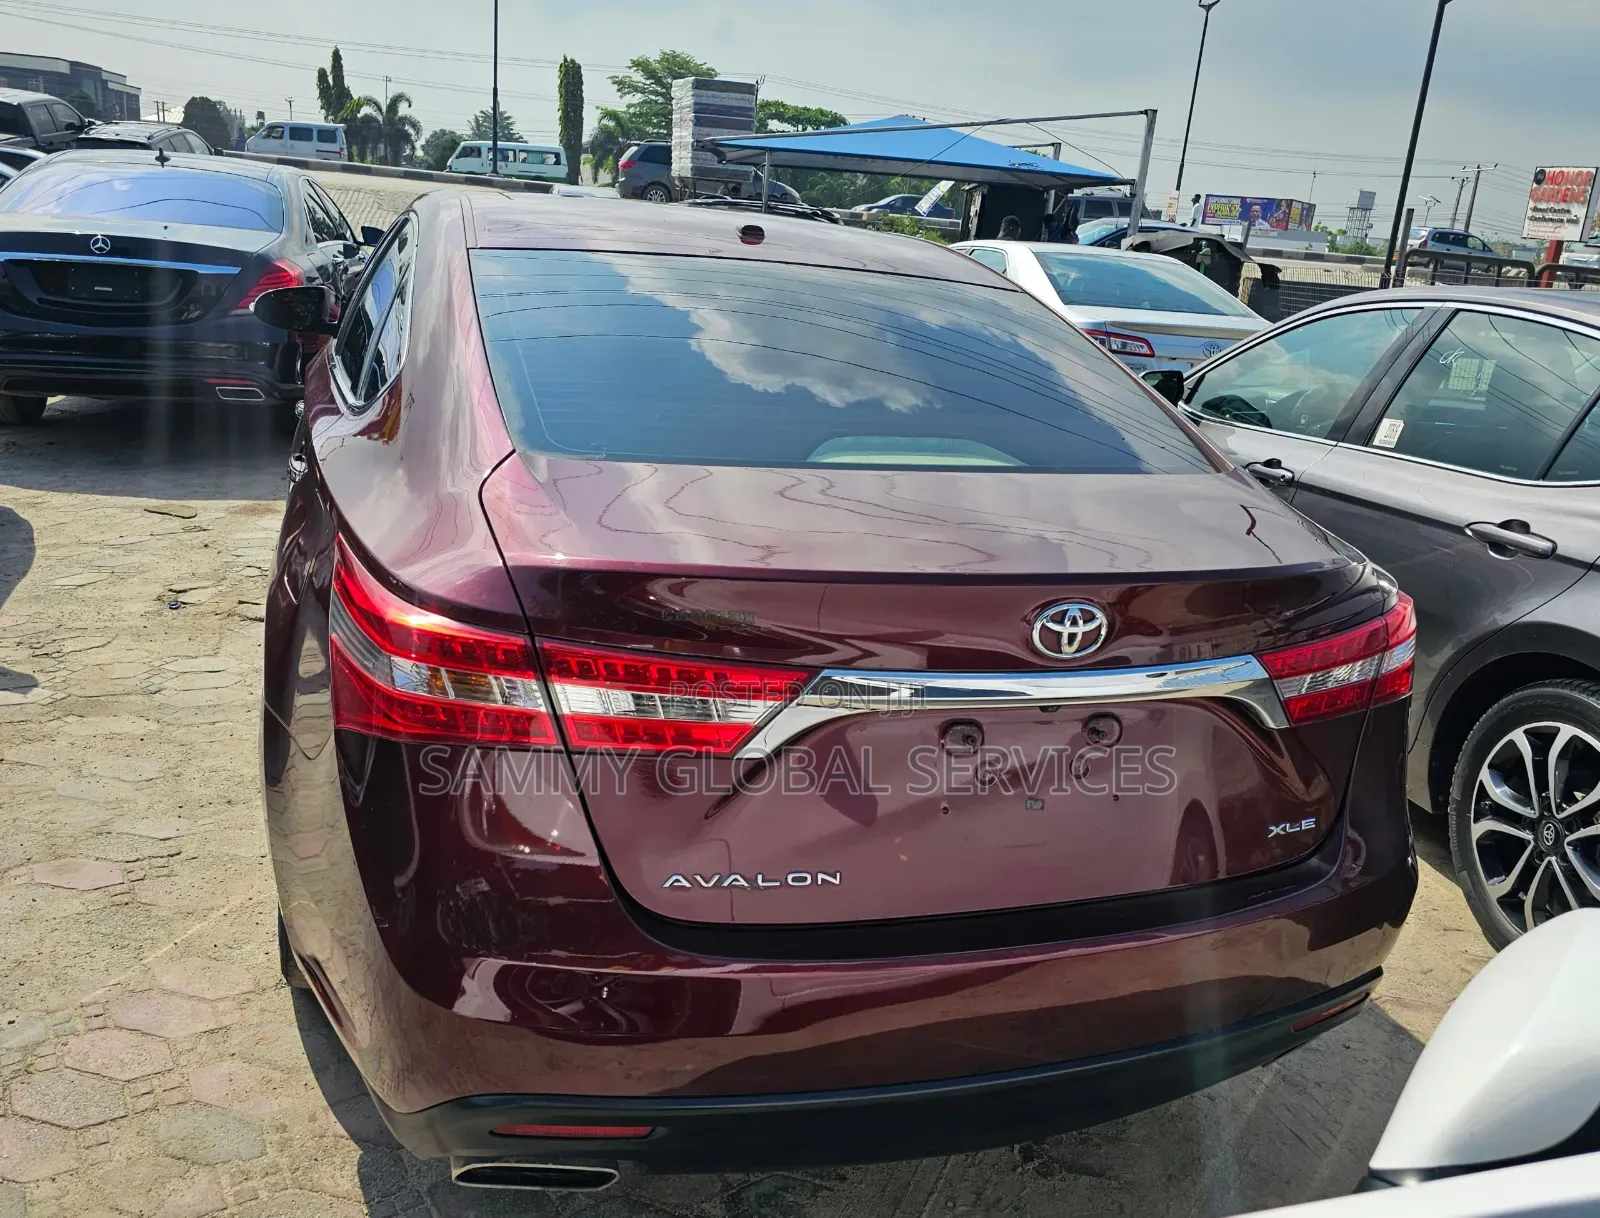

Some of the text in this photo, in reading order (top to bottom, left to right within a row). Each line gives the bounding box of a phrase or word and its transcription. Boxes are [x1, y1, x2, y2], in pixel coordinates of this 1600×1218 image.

[1545, 170, 1594, 186] HONOR
[1530, 187, 1587, 204] GARDENS
[1267, 818, 1316, 837] XLE
[662, 871, 842, 889] AVALON
